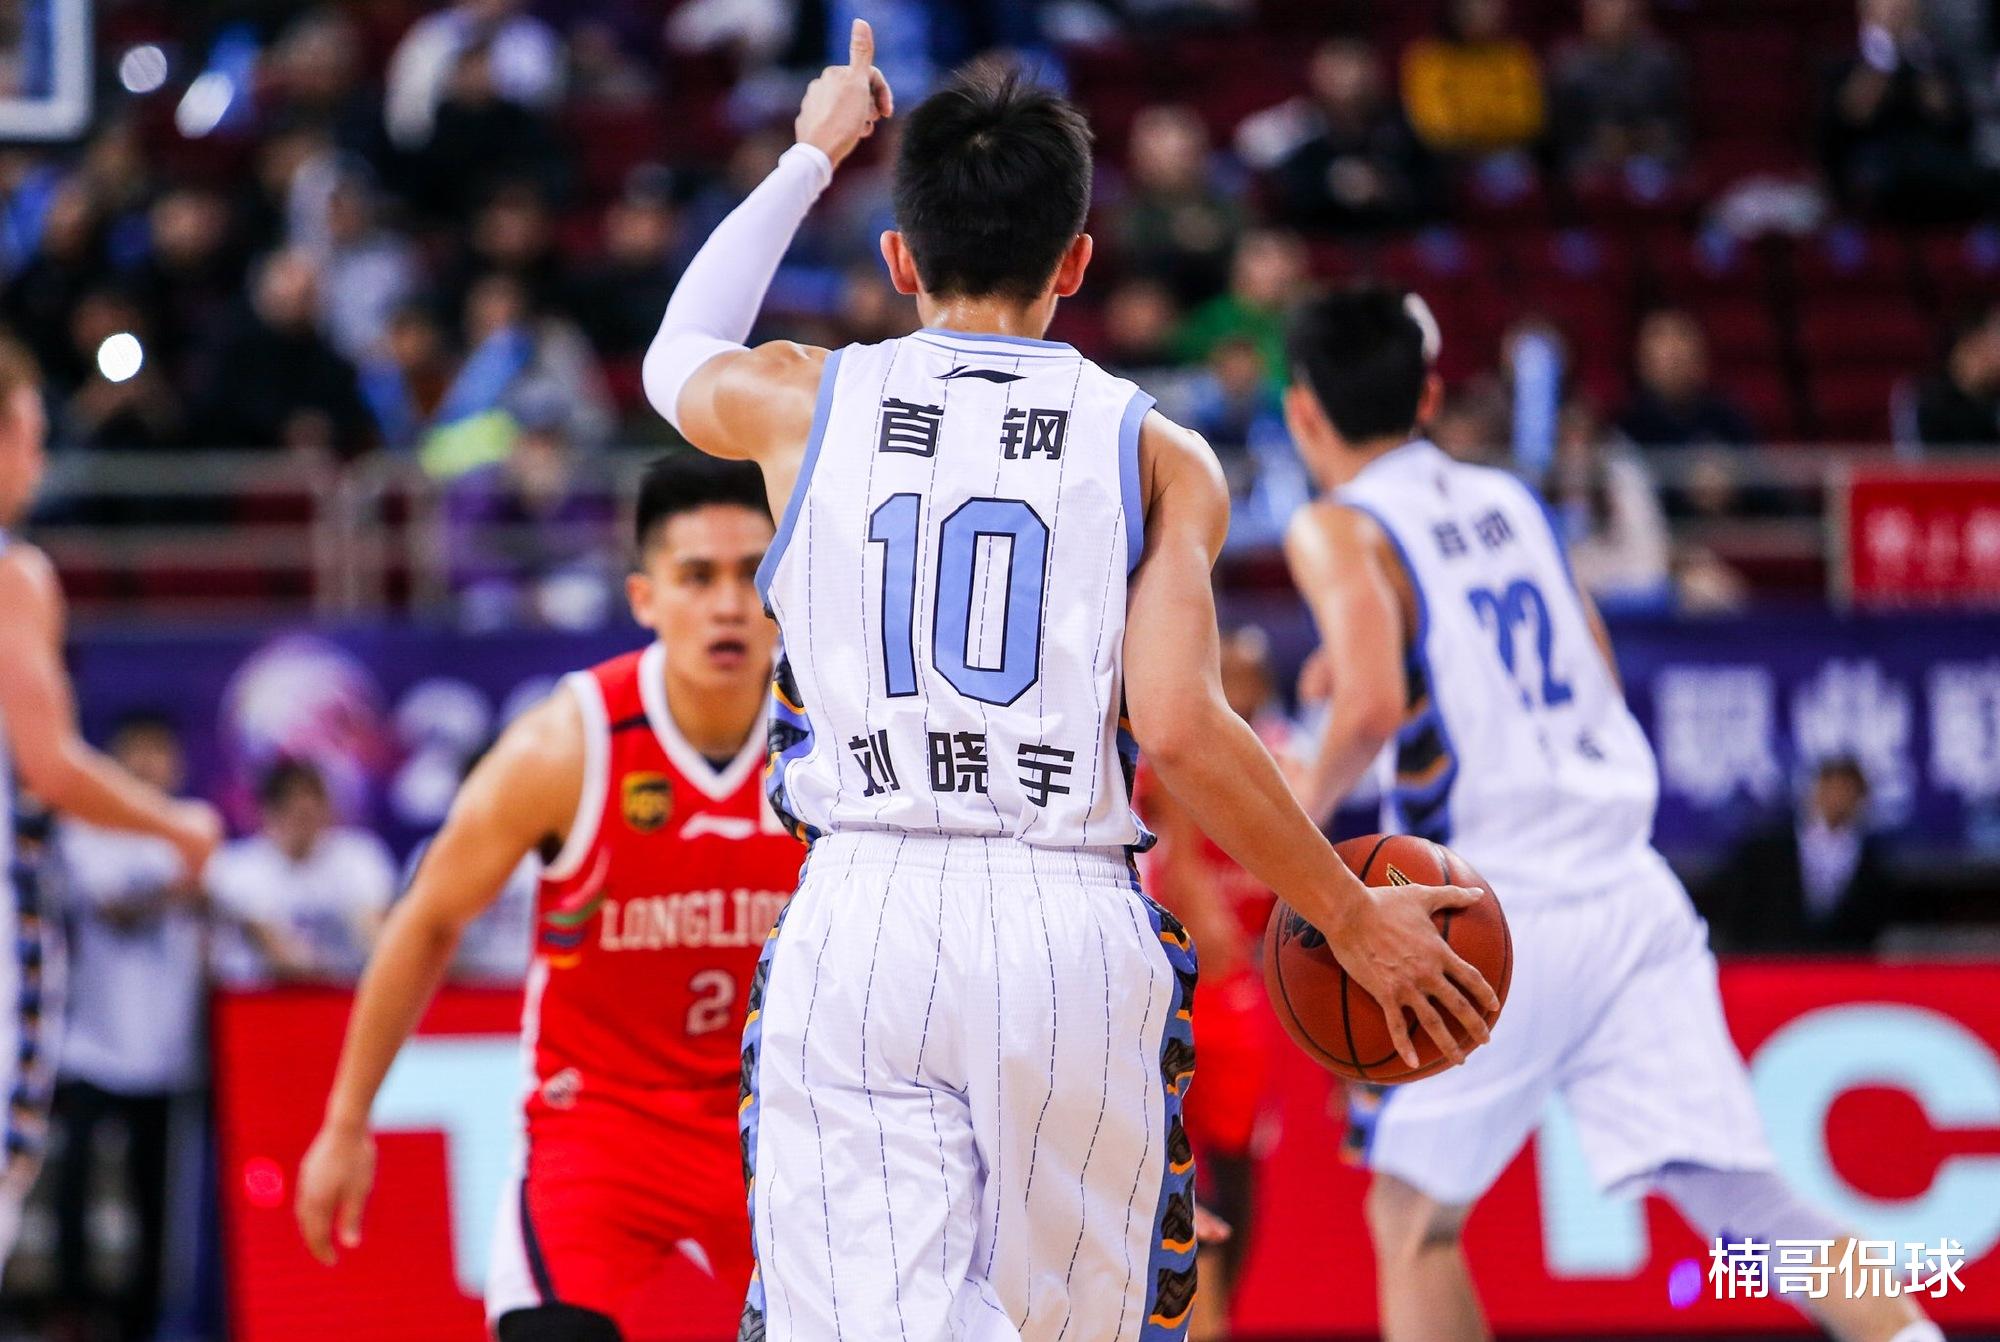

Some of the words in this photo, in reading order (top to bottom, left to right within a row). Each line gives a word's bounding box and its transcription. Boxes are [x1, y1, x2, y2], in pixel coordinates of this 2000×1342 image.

[878, 398, 1068, 460] 首钢
[868, 492, 1050, 708] 10
[848, 729, 1075, 807] 刘晓宇
[599, 887, 794, 951] LONGLIO
[685, 968, 737, 1036] 2
